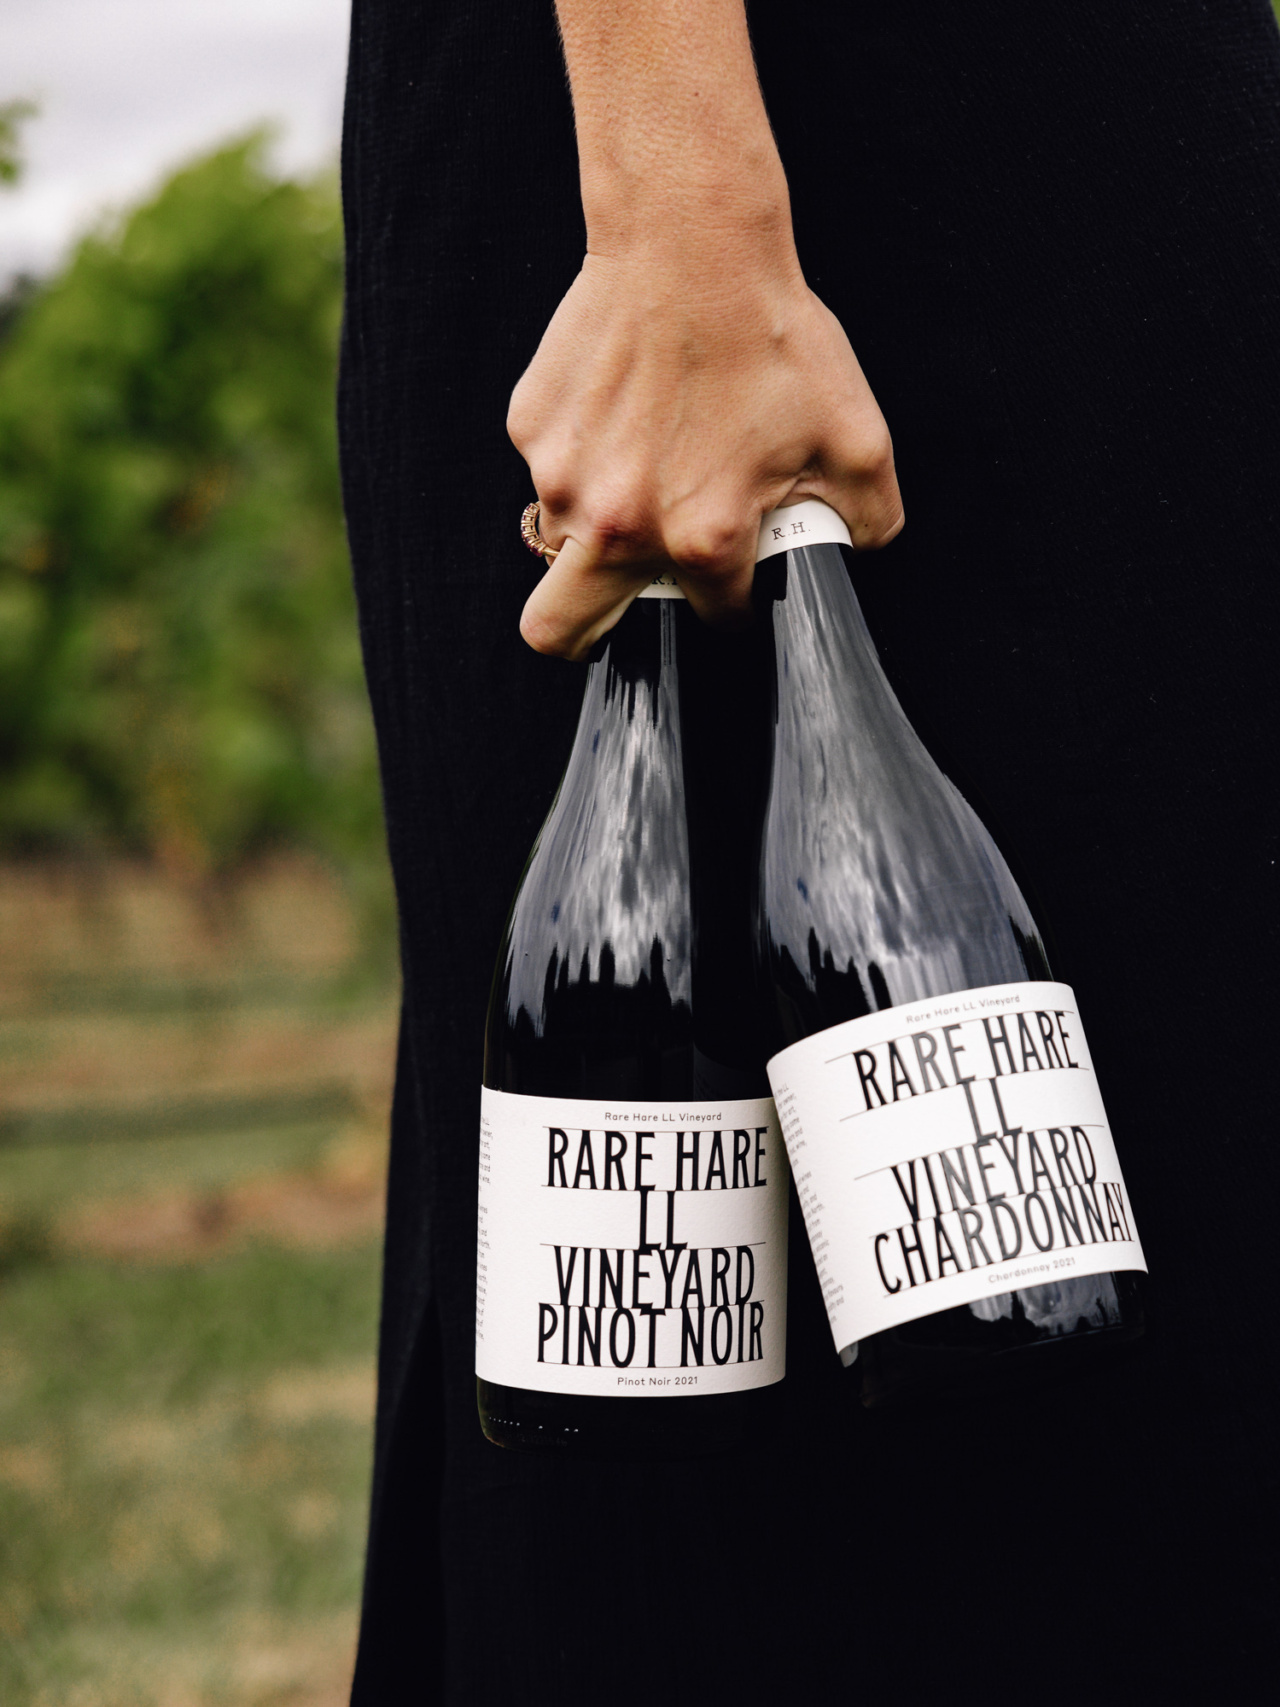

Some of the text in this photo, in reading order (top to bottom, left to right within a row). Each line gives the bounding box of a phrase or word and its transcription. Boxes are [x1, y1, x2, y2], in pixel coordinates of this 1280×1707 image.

[906, 994, 1021, 1024] Rare Hare LL Vineyard
[852, 1010, 1079, 1110] RARE HARE
[604, 1112, 722, 1123] Rare Hare LL Vineyard
[963, 1077, 1023, 1143] LL
[547, 1127, 656, 1191] RARE
[675, 1127, 768, 1191] HARE
[890, 1126, 1098, 1222] VINEYARD
[639, 1190, 688, 1250] LL
[874, 1182, 1135, 1294] CHARDONNAY
[553, 1245, 755, 1309] VINEYARD
[988, 1256, 1076, 1284] Chardonnay 2021
[537, 1302, 764, 1368] PINOT NOIR
[617, 1376, 698, 1386] Pinot Noir 2021
